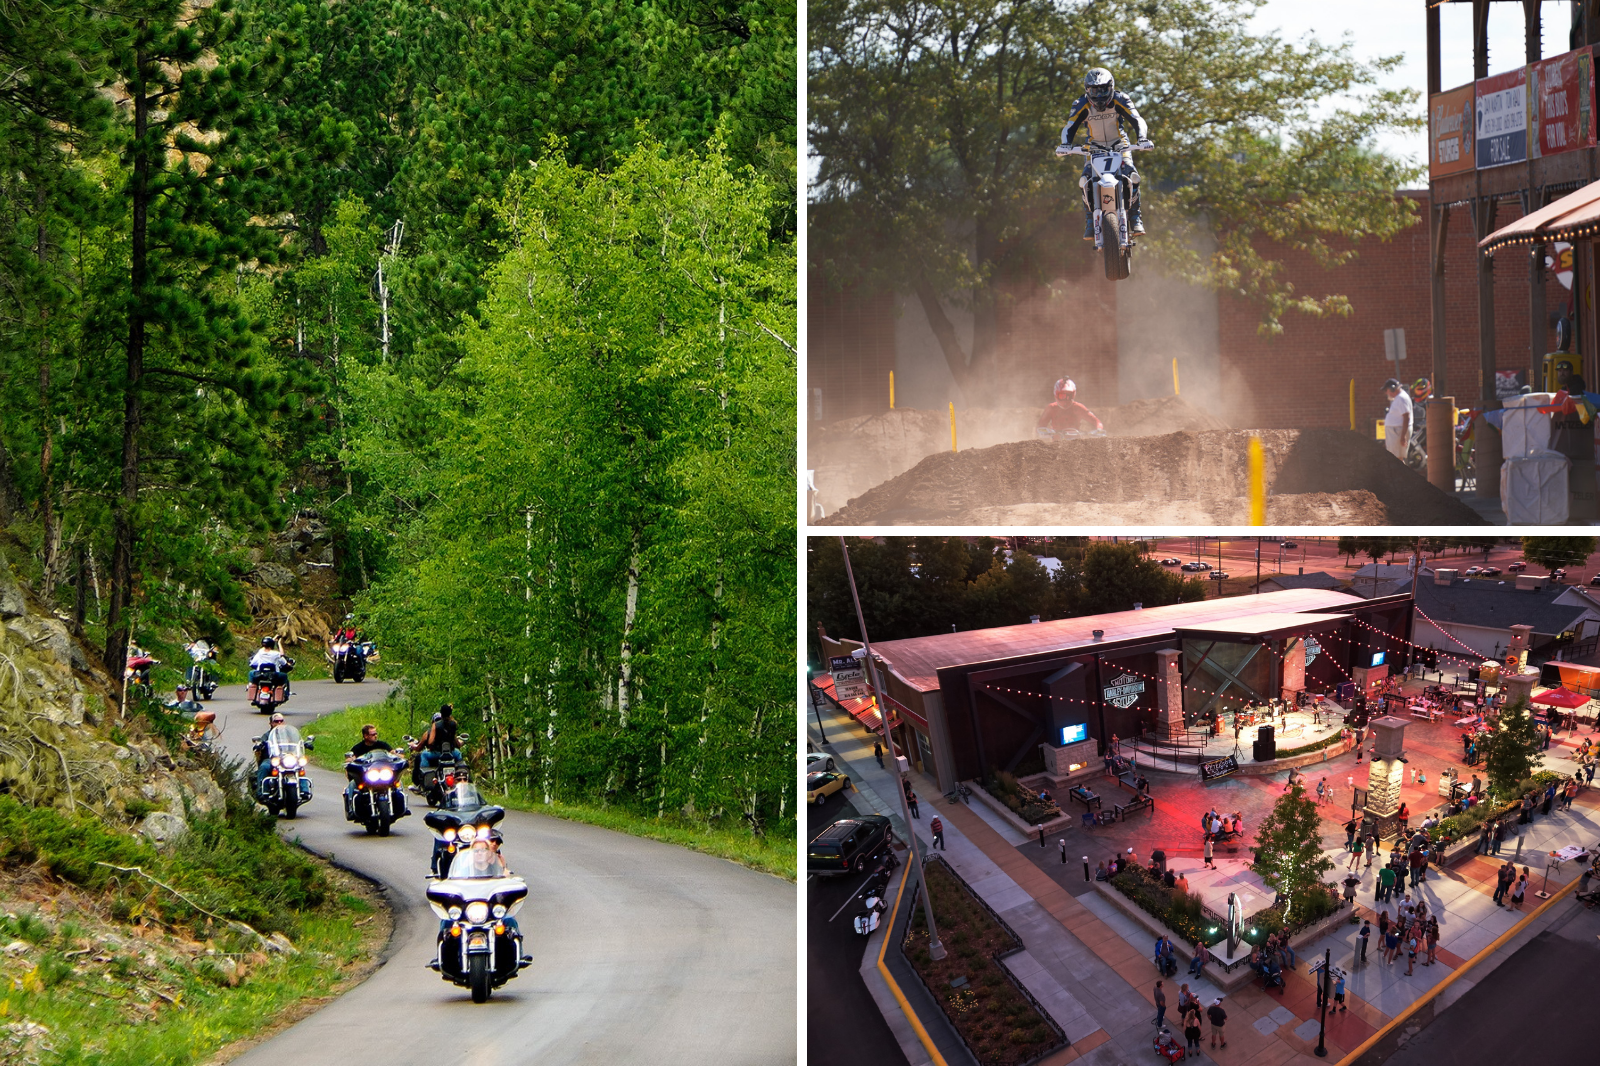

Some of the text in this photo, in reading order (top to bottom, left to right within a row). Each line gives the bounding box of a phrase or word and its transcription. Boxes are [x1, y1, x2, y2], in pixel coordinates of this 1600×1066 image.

[1087, 113, 1115, 121] PILOT
[1545, 94, 1555, 119] THIS
[1436, 104, 1463, 138] Budweiser
[1490, 135, 1511, 162] FOR SALE
[1546, 123, 1556, 149] FOR
[1103, 157, 1113, 171] 1
[1115, 676, 1134, 686] MOTOR
